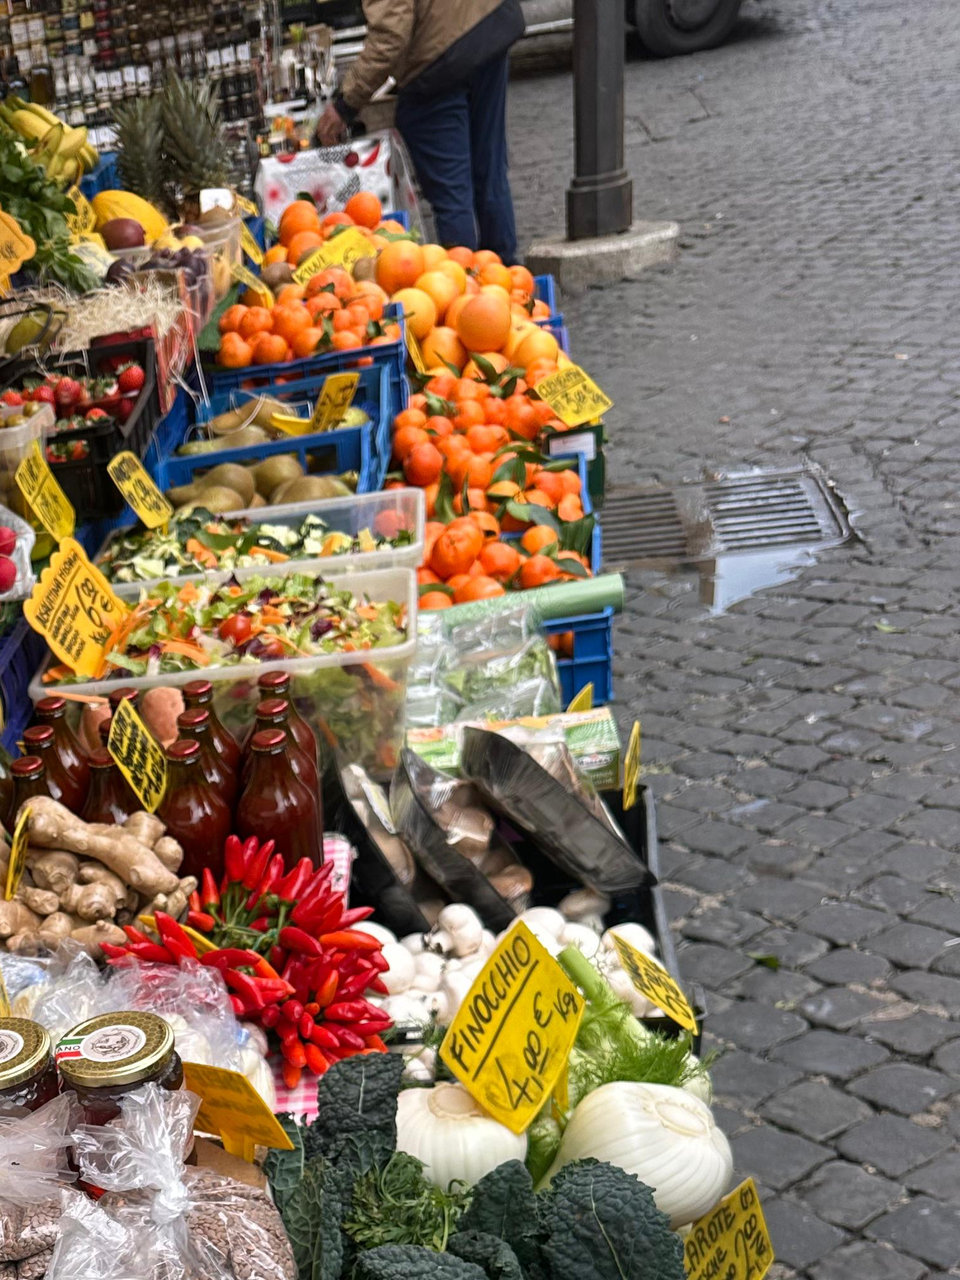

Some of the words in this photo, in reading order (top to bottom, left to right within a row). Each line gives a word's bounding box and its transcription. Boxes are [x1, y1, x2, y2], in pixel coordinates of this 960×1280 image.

[449, 935, 531, 1073] FINOCCHIO
[532, 991, 554, 1030] €
[686, 1204, 737, 1275] AROTE
